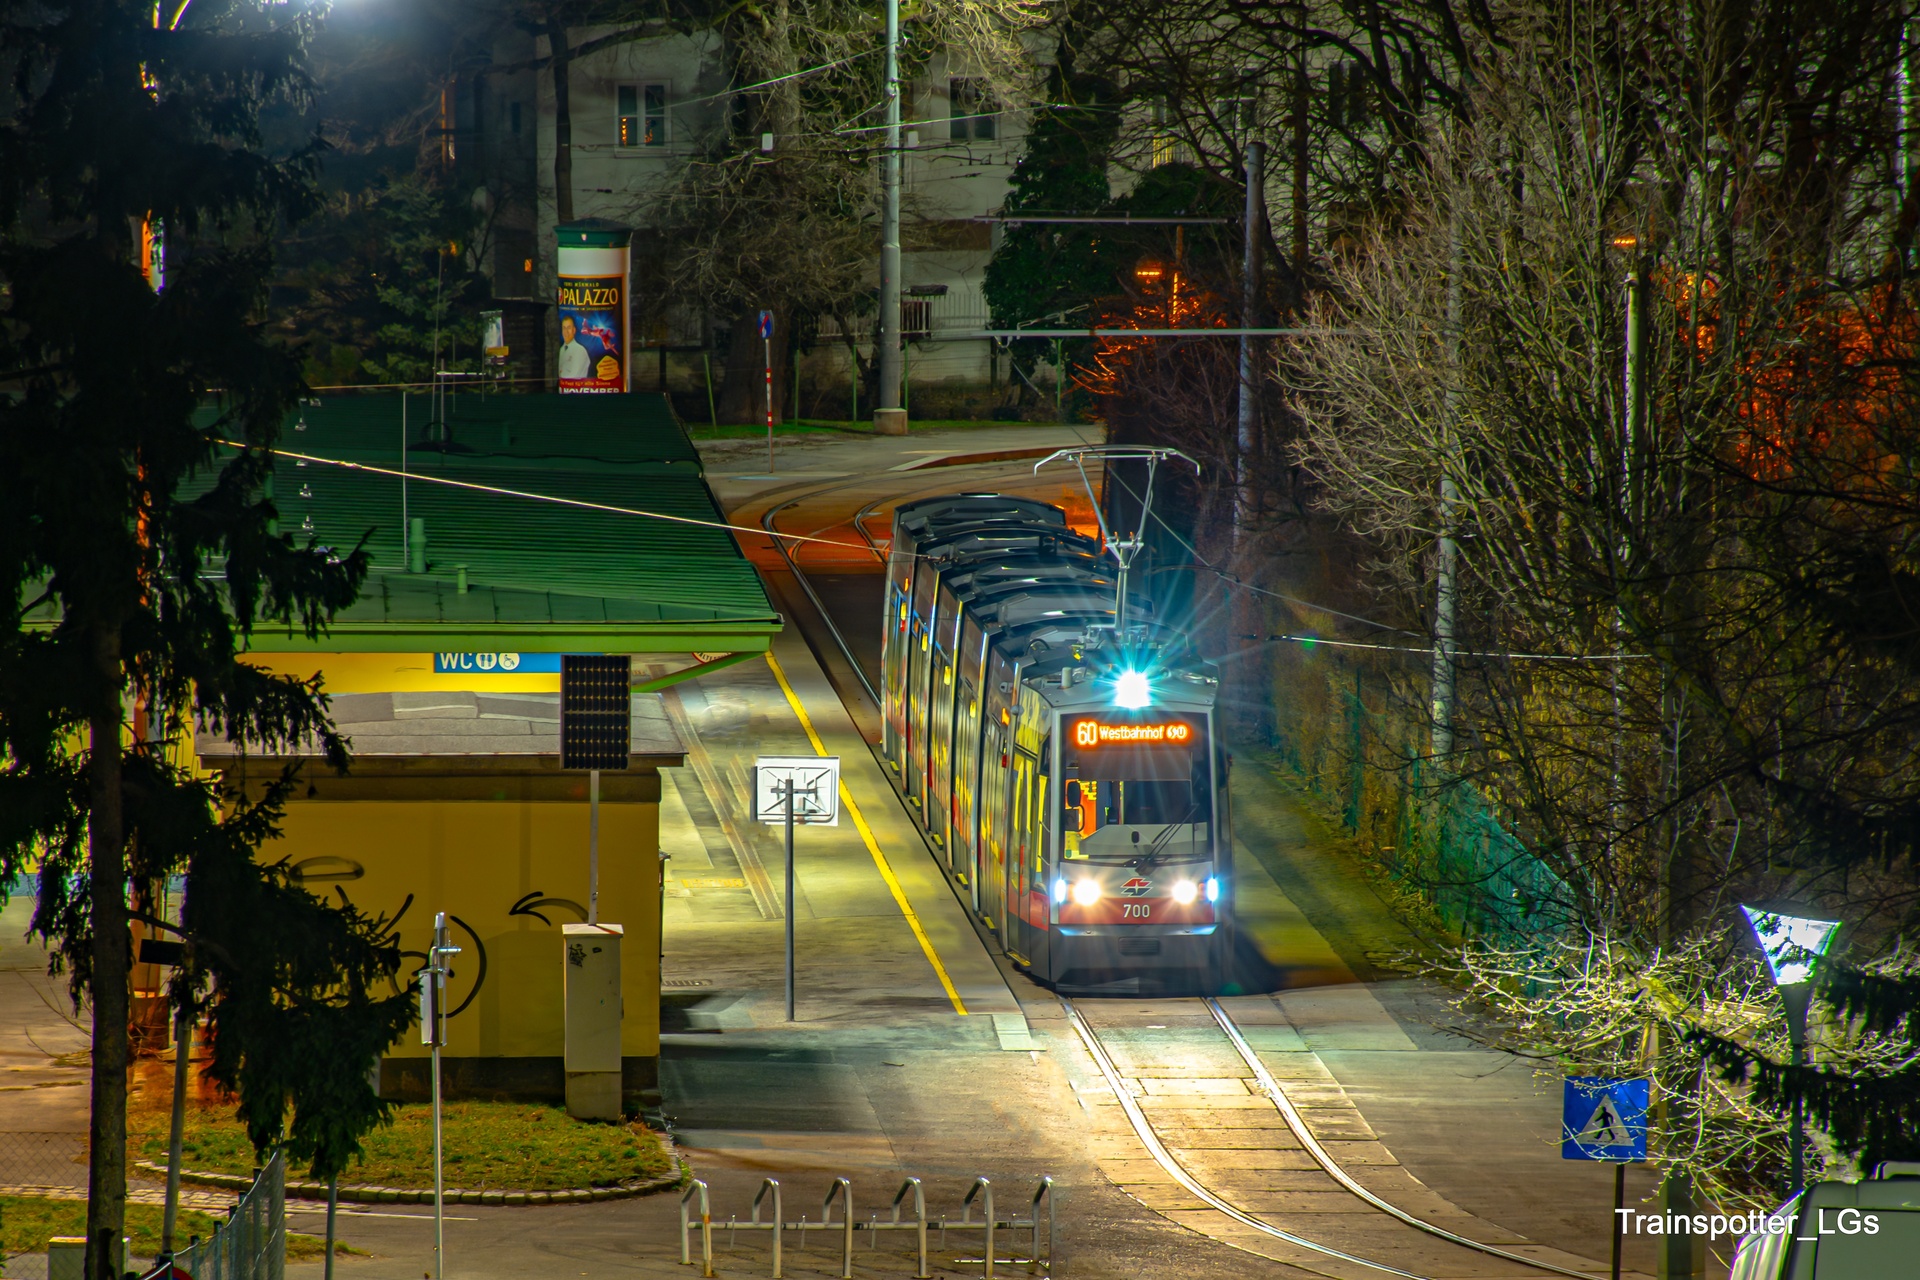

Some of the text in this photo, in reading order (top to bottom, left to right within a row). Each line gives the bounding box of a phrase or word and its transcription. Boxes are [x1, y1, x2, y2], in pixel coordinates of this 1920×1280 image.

[563, 288, 618, 305] PALAZZO
[440, 652, 473, 670] WC
[1077, 721, 1098, 746] 60
[1099, 725, 1165, 740] Westbahnhof
[1123, 904, 1150, 918] 700
